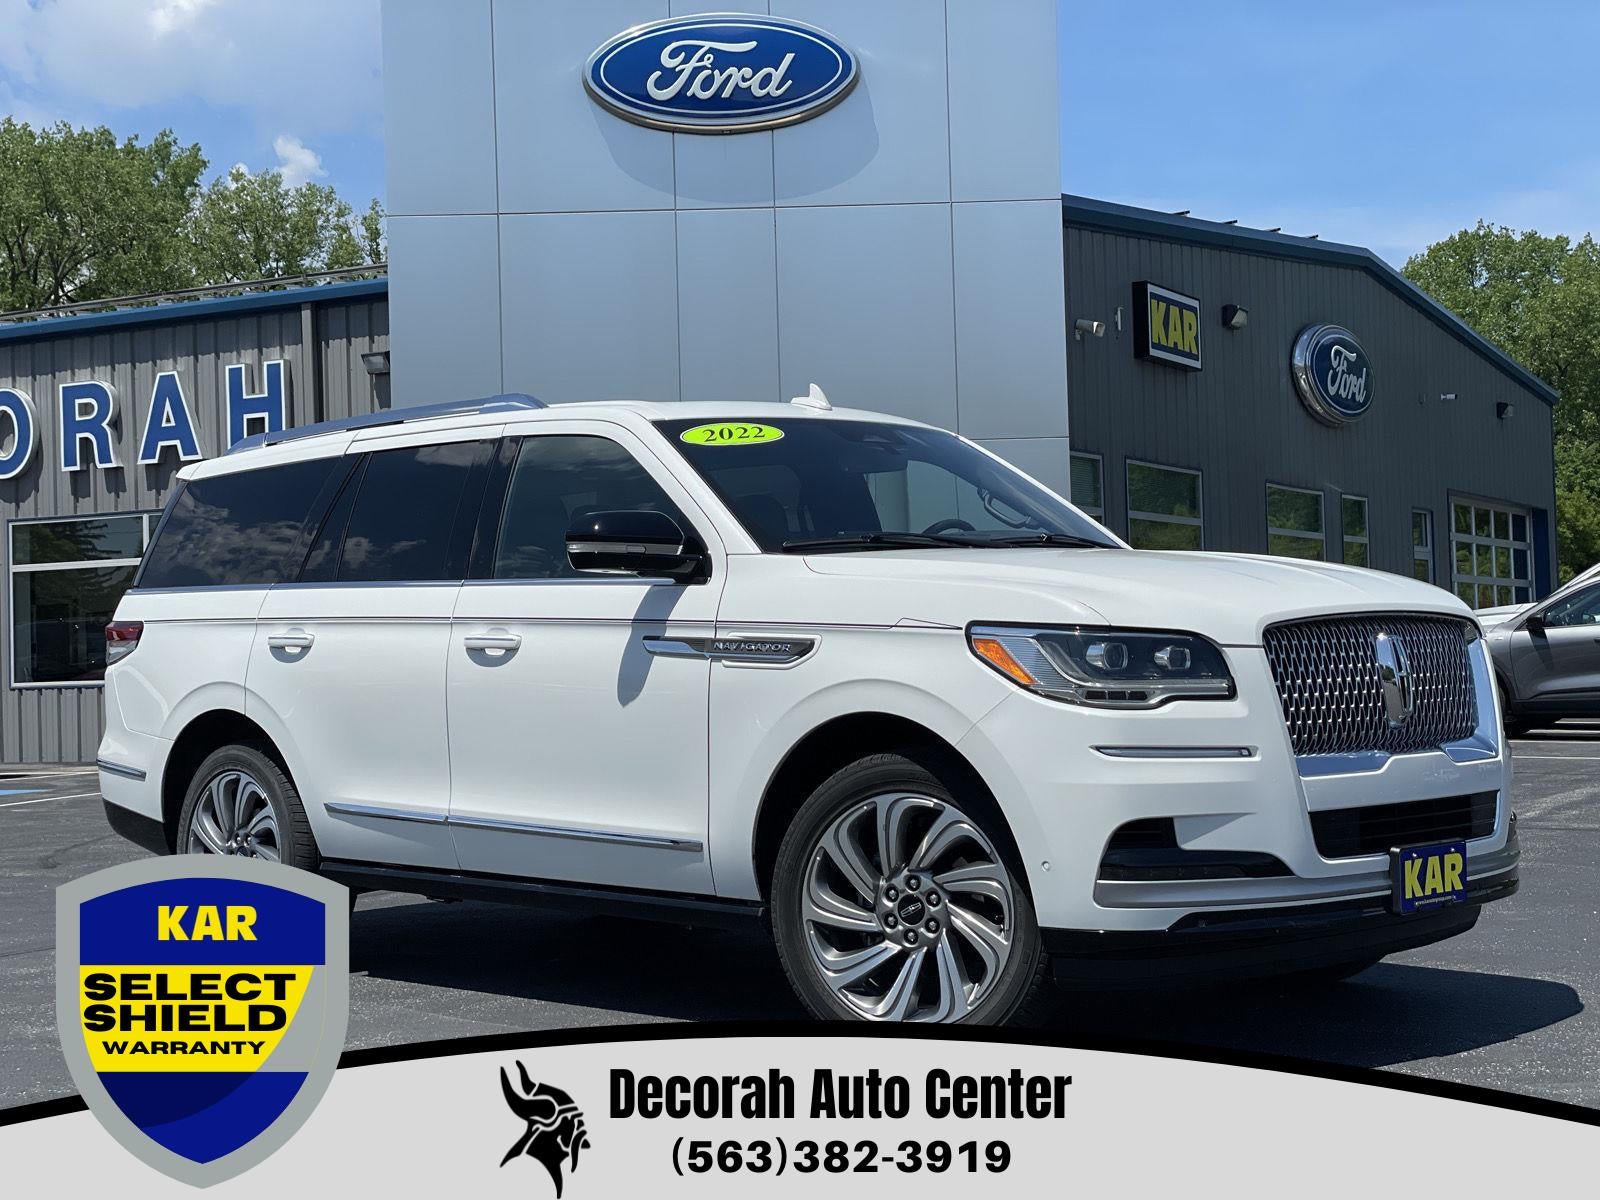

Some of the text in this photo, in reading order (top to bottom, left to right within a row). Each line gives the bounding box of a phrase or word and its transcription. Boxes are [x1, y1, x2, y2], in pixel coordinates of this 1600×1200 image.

[646, 39, 795, 101] Ford
[1151, 299, 1198, 355] KAR
[1327, 345, 1366, 403] Ford
[702, 426, 766, 442] 2022
[713, 641, 793, 652] NAVIGATOR
[1404, 852, 1463, 900] KAR
